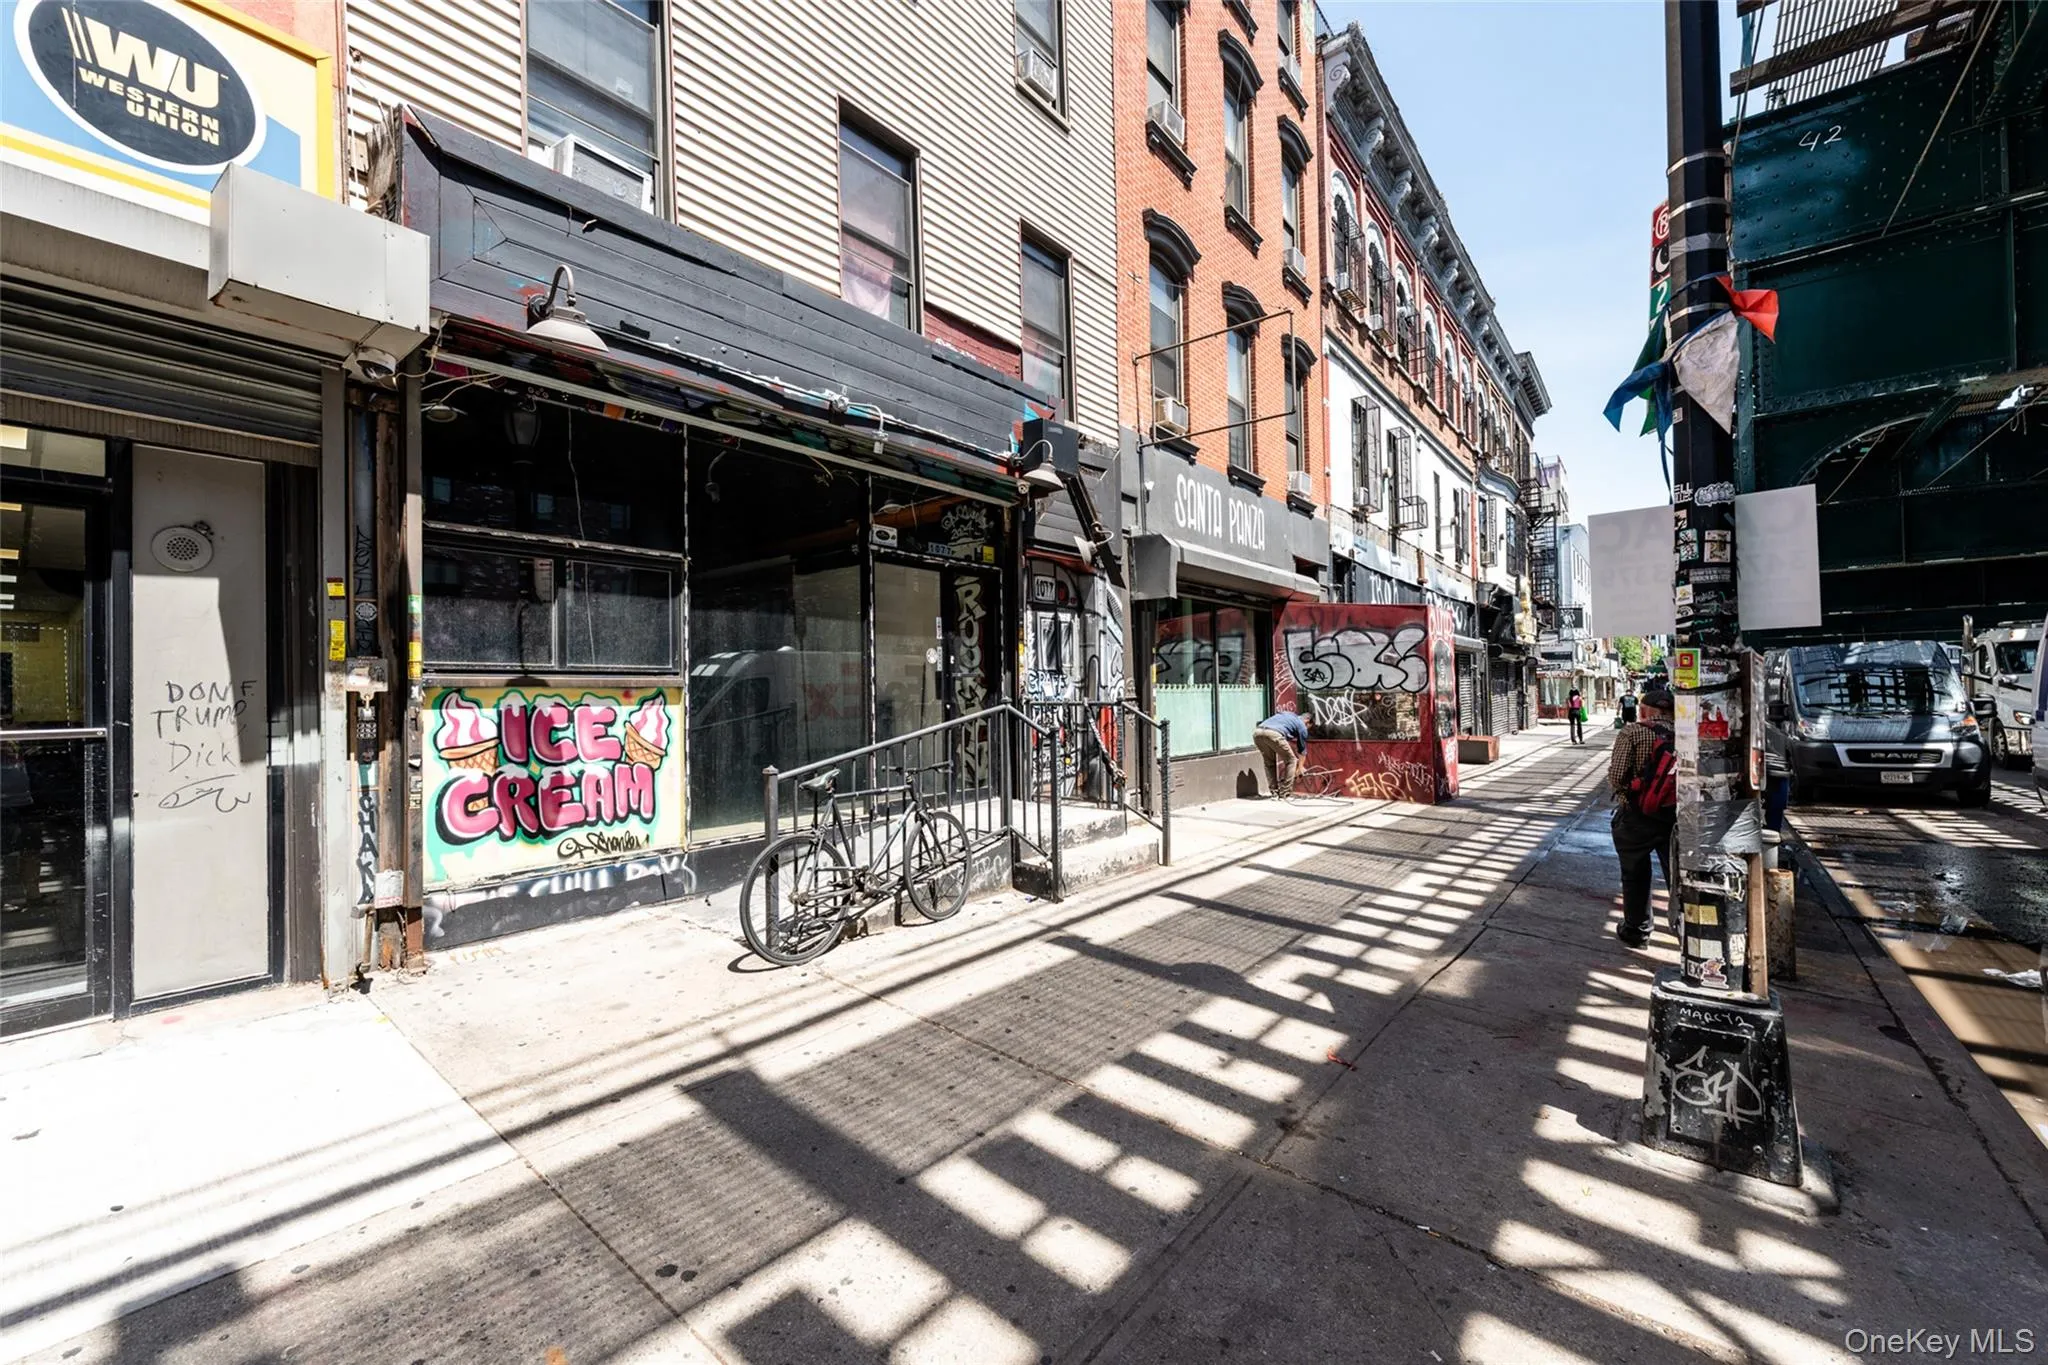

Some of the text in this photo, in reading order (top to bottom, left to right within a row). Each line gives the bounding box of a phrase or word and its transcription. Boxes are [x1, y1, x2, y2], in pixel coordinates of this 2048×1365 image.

[80, 67, 220, 133] WESTERN
[126, 99, 220, 147] UNION
[1798, 124, 1843, 152] 42
[1174, 473, 1266, 552] SANTA PANZA
[164, 738, 238, 773] Dick
[500, 690, 623, 763] ICE
[438, 762, 656, 843] CREAM
